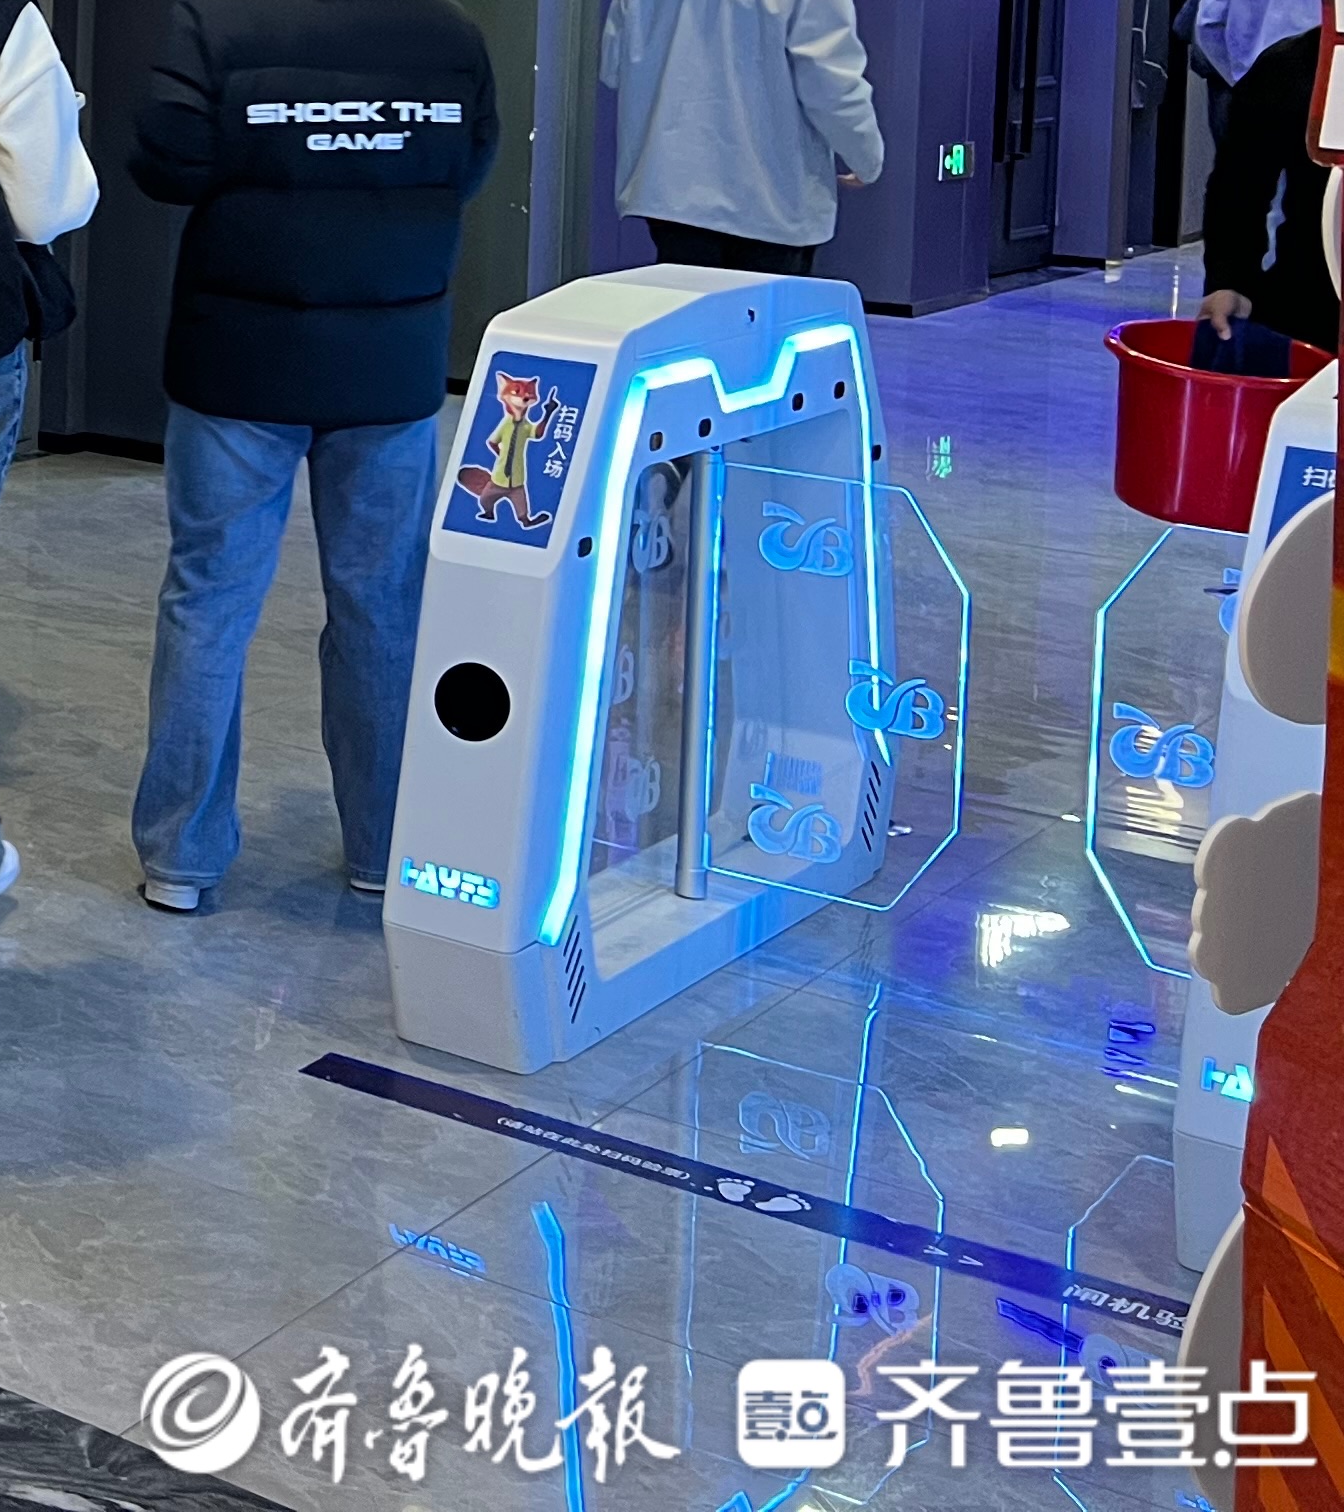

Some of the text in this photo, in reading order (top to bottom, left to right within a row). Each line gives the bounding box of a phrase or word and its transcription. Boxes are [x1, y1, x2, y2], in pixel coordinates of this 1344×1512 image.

[246, 101, 462, 125] SHOCK THE
[542, 404, 579, 479] 扫码入场
